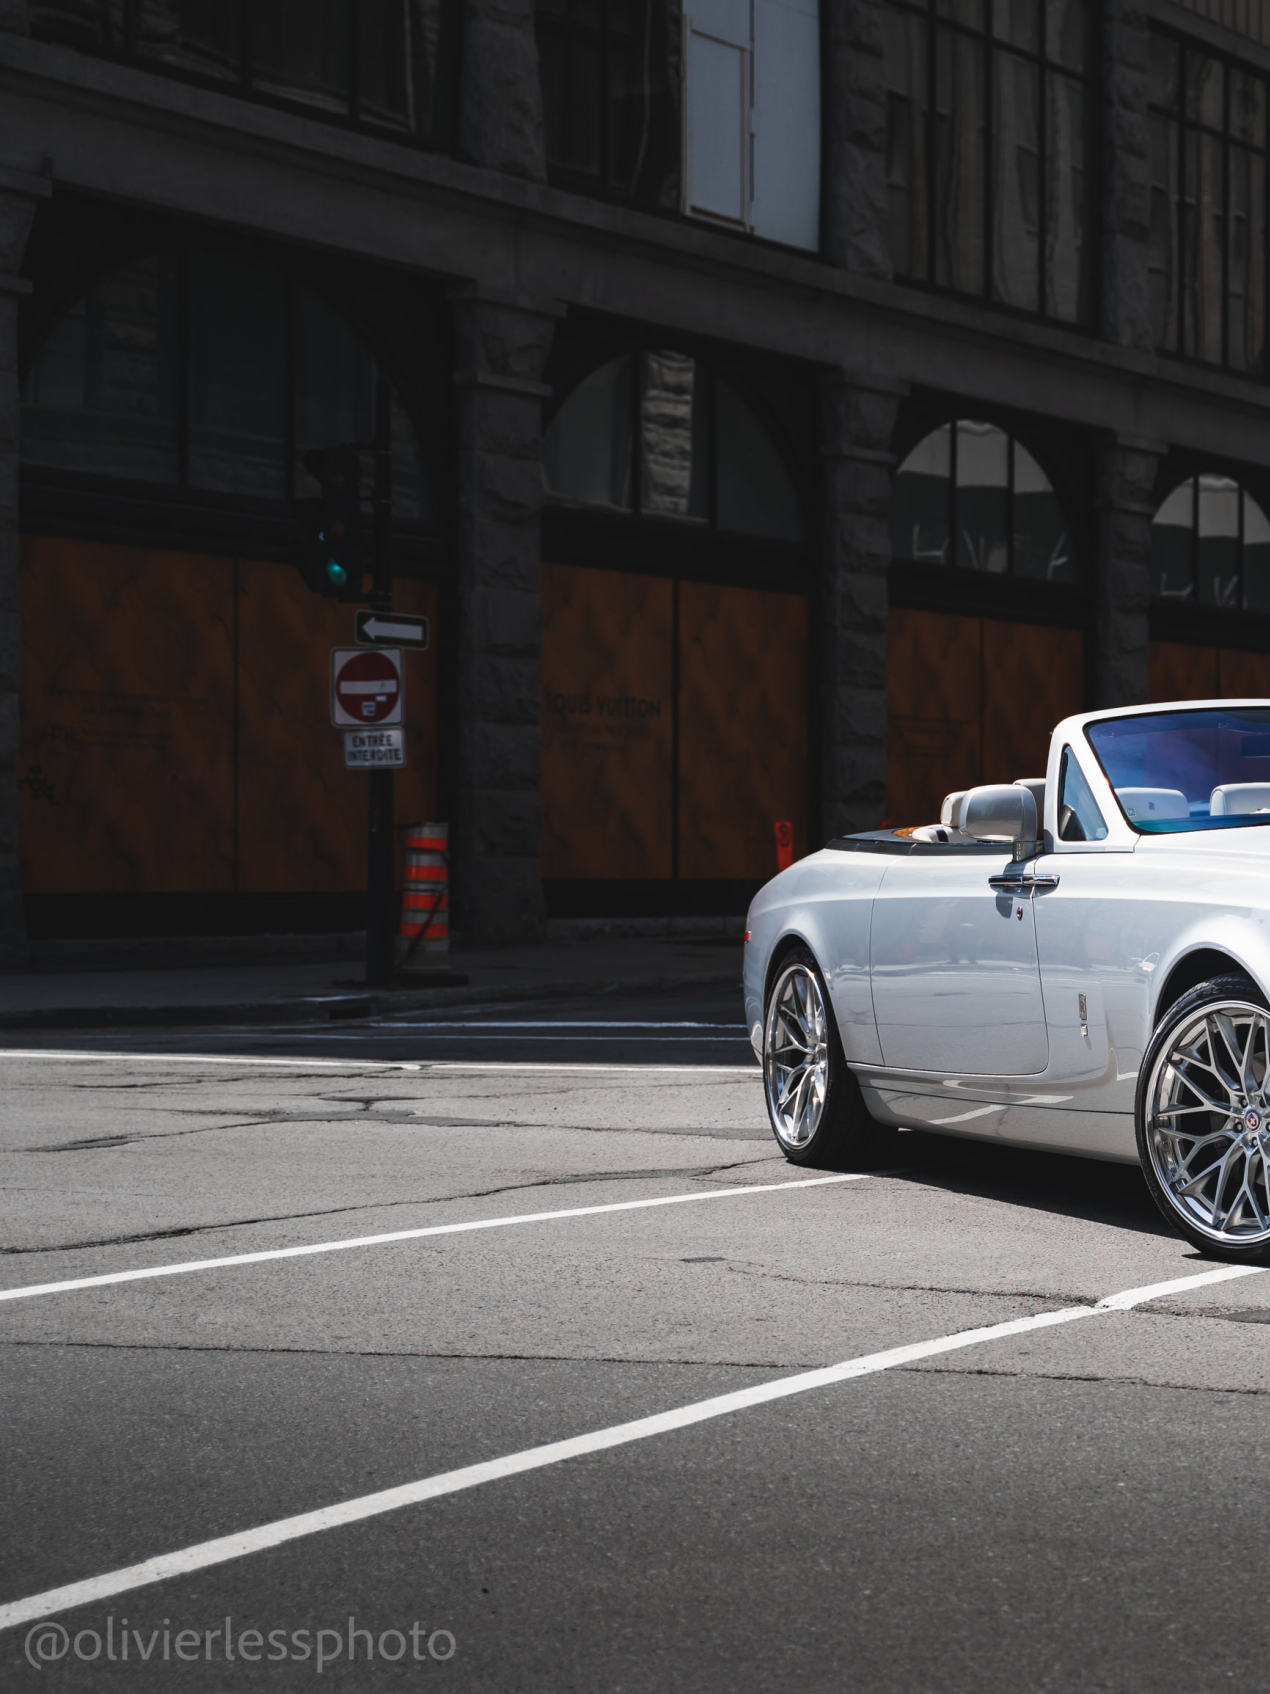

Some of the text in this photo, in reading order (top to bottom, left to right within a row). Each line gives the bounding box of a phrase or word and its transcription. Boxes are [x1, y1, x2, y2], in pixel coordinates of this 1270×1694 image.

[543, 689, 662, 718] LOUIS VUITTON
[352, 733, 393, 748] ENTRÉE
[347, 748, 402, 762] INTERDITE
